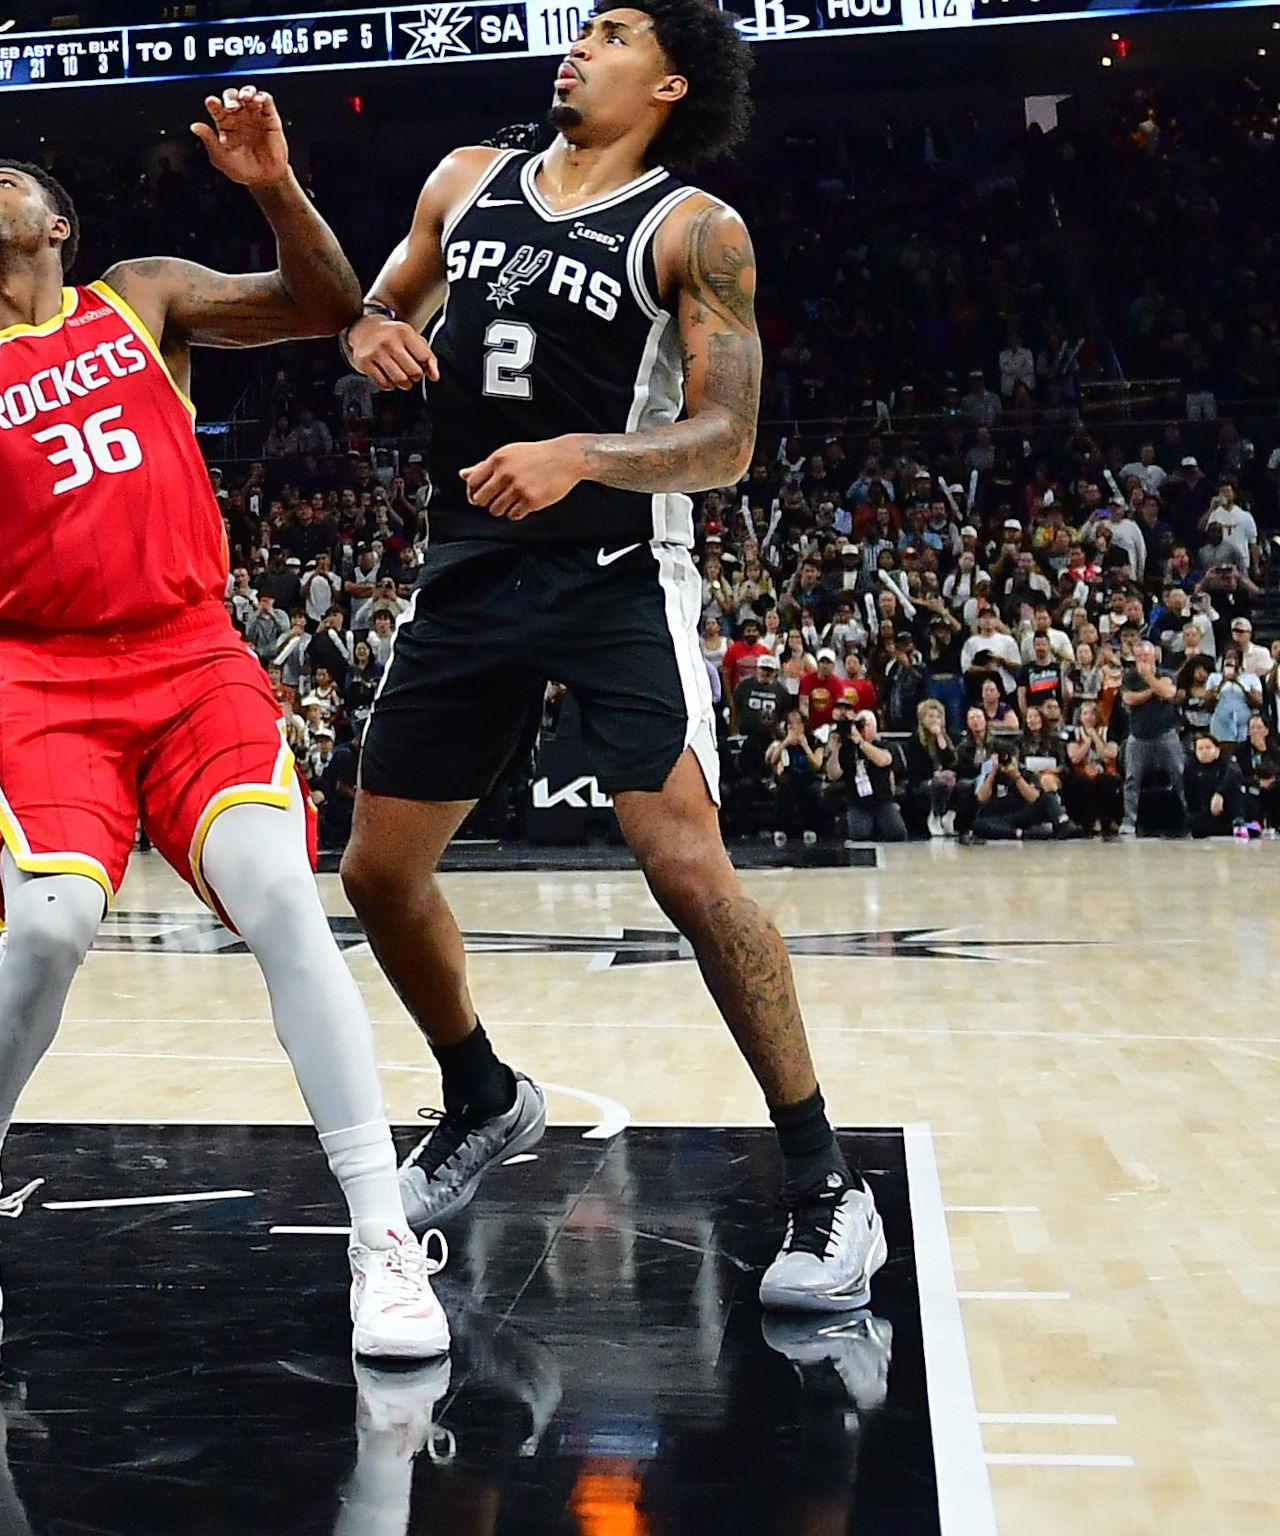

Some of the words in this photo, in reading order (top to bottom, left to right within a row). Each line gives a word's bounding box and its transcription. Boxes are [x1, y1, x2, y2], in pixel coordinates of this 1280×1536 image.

[136, 42, 172, 62] TO
[184, 36, 196, 61] 0
[209, 36, 265, 57] FG%
[314, 29, 348, 50] PF
[361, 24, 373, 49] 5
[481, 14, 525, 44] SA
[540, 7, 579, 46] 110
[23, 44, 54, 57] AST
[57, 43, 87, 56] STL
[89, 40, 119, 54] BLK
[30, 58, 45, 79] 21
[63, 56, 78, 76] 10
[98, 54, 109, 74] 3
[446, 239, 622, 322] SPURS
[482, 319, 537, 401] 2
[32, 404, 143, 496] 36
